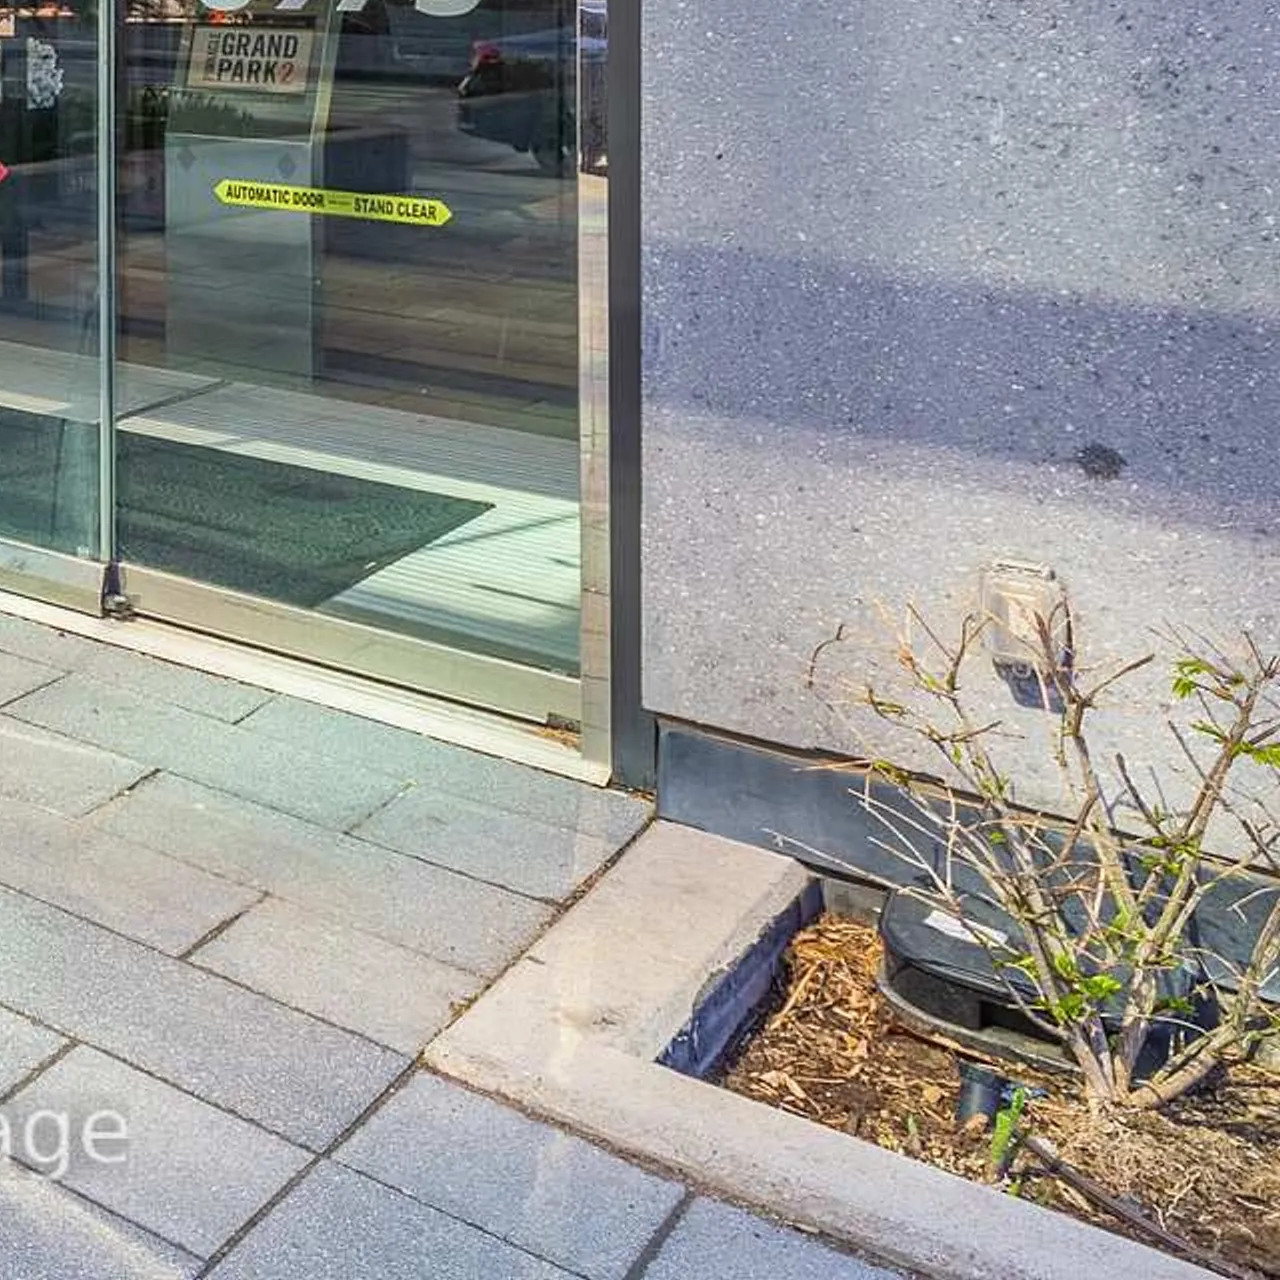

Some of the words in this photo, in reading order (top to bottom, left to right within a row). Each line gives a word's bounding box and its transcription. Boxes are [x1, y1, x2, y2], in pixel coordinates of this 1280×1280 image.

[221, 31, 299, 59] GRAND
[226, 185, 290, 205] AUTOMATIC
[292, 192, 325, 208] DOOR
[352, 197, 394, 214] STAND
[396, 203, 438, 221] CLEAR
